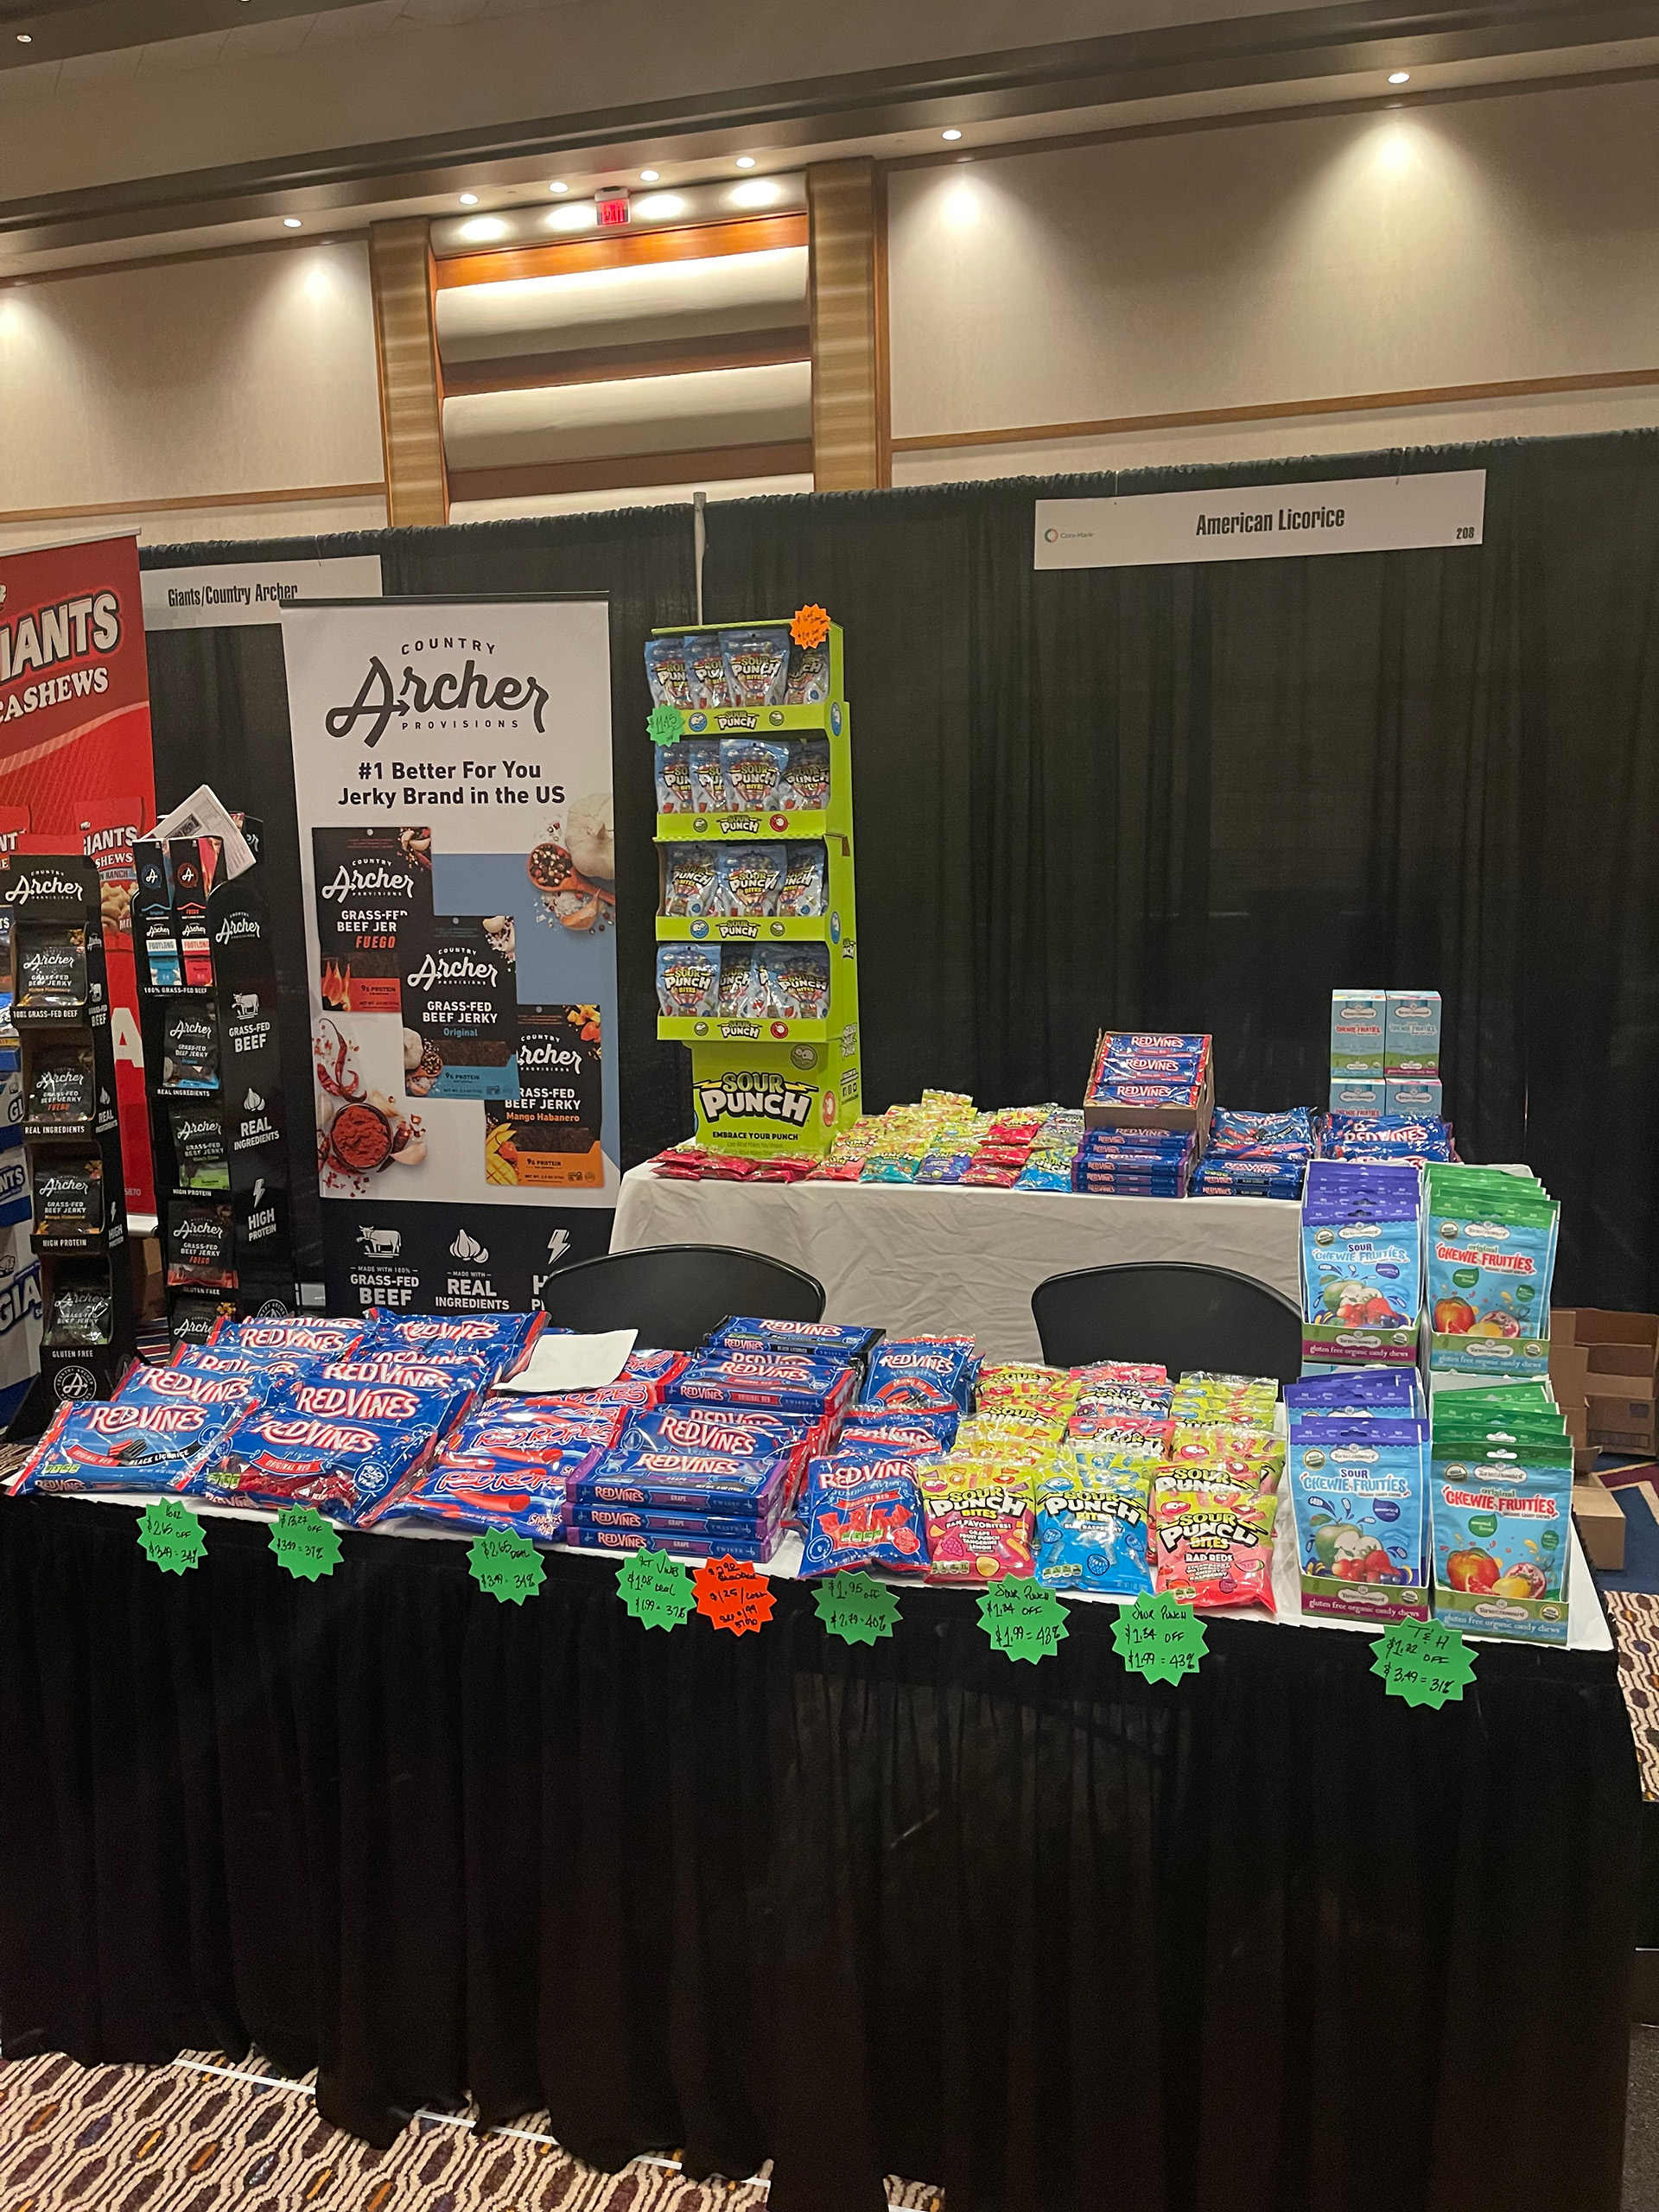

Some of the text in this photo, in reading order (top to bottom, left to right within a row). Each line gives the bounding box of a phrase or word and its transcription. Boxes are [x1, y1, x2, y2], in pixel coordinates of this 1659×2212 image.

[1196, 506, 1344, 536] American Licorice
[1456, 527, 1474, 539] 208
[168, 582, 298, 607] Giants/Country Archer
[401, 637, 495, 655] COUNTRY
[325, 655, 550, 748] Archer
[402, 720, 518, 730] PROVISIONS
[718, 715, 757, 730] PUNCH
[358, 760, 541, 779] #1 Better For You
[733, 772, 778, 787] PUNCH
[337, 785, 565, 809] Jerky Brand in the US
[720, 820, 760, 834] PUNCH
[5, 874, 83, 905] Archer
[321, 865, 414, 903] Archer
[216, 918, 260, 944] Archer
[720, 925, 759, 938] PUNCH
[356, 936, 396, 949] FUEGO
[407, 954, 499, 991] Archer
[664, 976, 712, 991] PUNCH
[427, 1001, 492, 1012] GRASS-FED
[423, 1012, 498, 1024] BEEF JERKY
[169, 1020, 212, 1039] Archer
[229, 1021, 270, 1037] GRASS-FED
[443, 1027, 478, 1038] Original
[721, 1025, 760, 1039] PUNCH
[234, 1033, 267, 1052] BEEF
[721, 1072, 785, 1094] SOUR
[505, 1099, 581, 1110] BEEF JERKY
[701, 1090, 811, 1127] PUNCH
[506, 1111, 580, 1122] Mango Habanero
[24, 1126, 41, 1135] REAL
[177, 1121, 222, 1141] Archer
[240, 1117, 272, 1137] REAL
[233, 1131, 280, 1151] INGREDIENTS
[39, 1178, 88, 1198] Archer
[248, 1208, 275, 1230] HIGH
[173, 1220, 224, 1239] Archer
[248, 1224, 276, 1242] PROTEIN
[1314, 1247, 1406, 1262] CHEWIE FRUITIES
[1348, 1243, 1372, 1252] SOUR
[1468, 1243, 1498, 1255] original
[1438, 1246, 1478, 1265] CHEWIE
[1481, 1253, 1534, 1271] FRUITIES
[350, 1274, 419, 1287] GRASS-FED
[447, 1278, 497, 1297] REAL
[359, 1287, 412, 1306] BEEF
[435, 1296, 510, 1311] INGREDIENTS
[1310, 1345, 1329, 1354] gluten
[1330, 1345, 1344, 1354] free
[1344, 1348, 1368, 1357] organic
[1369, 1349, 1388, 1358] candy
[265, 1459, 295, 1471] ORIGINAL
[1341, 1469, 1368, 1478] SOUR
[1174, 1467, 1230, 1484] SOUR
[1303, 1476, 1407, 1493] CHEWIE FRUITIES
[1481, 1488, 1516, 1498] original
[949, 1486, 1004, 1503] SOUR
[930, 1496, 1028, 1519] PUNCH
[1446, 1491, 1555, 1516] CHEWIE FRUITIES
[961, 1509, 998, 1520] BITES
[1044, 1496, 1141, 1529] PUNCH
[1179, 1513, 1236, 1527] SOUR
[946, 1520, 1012, 1529] FAN FAVORITES!
[1160, 1522, 1260, 1554] PUNCH
[1185, 1553, 1235, 1563] RAD REDS
[828, 1580, 863, 1599] $1.95
[1309, 1599, 1420, 1618] gluten free organic candy chews
[864, 1614, 887, 1631] 40%
[1444, 1614, 1560, 1634] gluten free organic candy chews
[995, 1624, 1024, 1647] $1.99
[1124, 1624, 1185, 1644] $1.34 OFF
[1169, 1652, 1196, 1669] 43%
[1423, 1654, 1449, 1663] OFF
[1429, 1678, 1455, 1694] 31%
